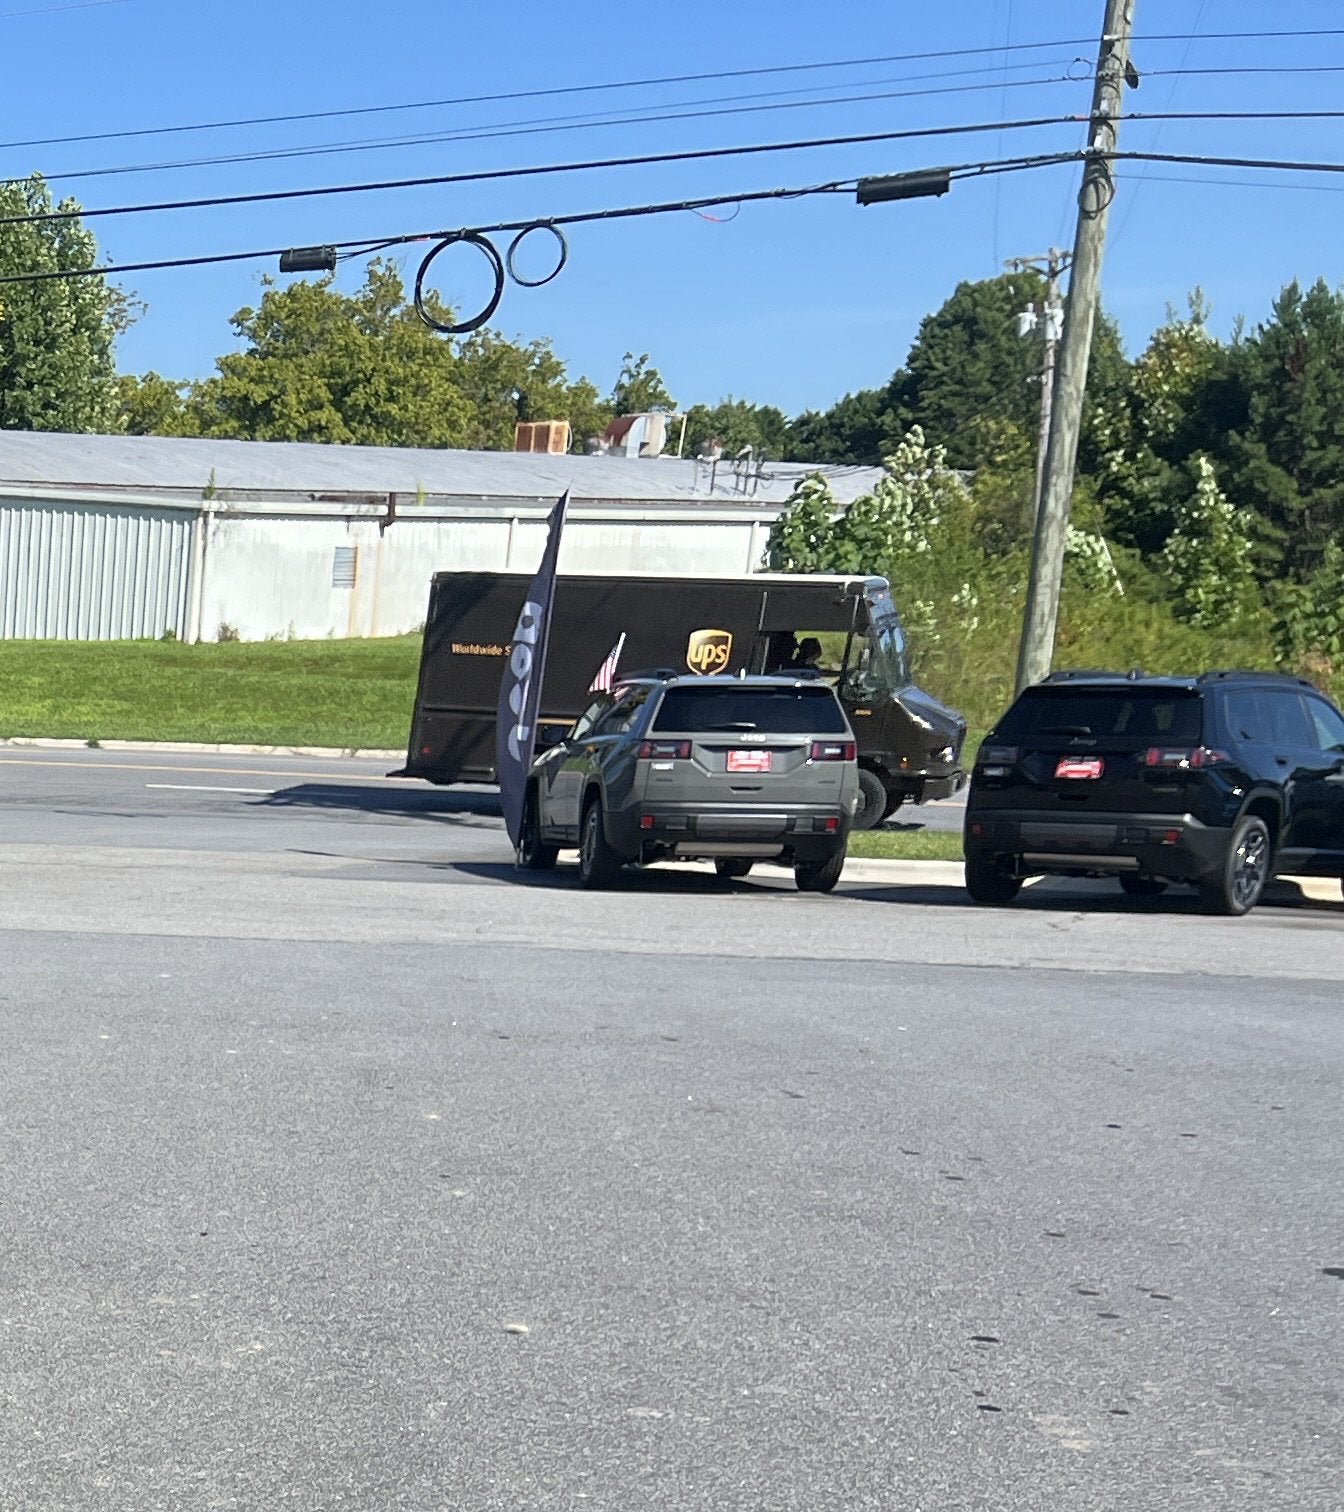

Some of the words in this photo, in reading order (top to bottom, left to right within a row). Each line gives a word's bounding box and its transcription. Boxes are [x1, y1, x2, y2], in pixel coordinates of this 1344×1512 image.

[451, 643, 503, 657] Worldwide
[690, 644, 728, 671] ups
[740, 733, 766, 743] Jeep
